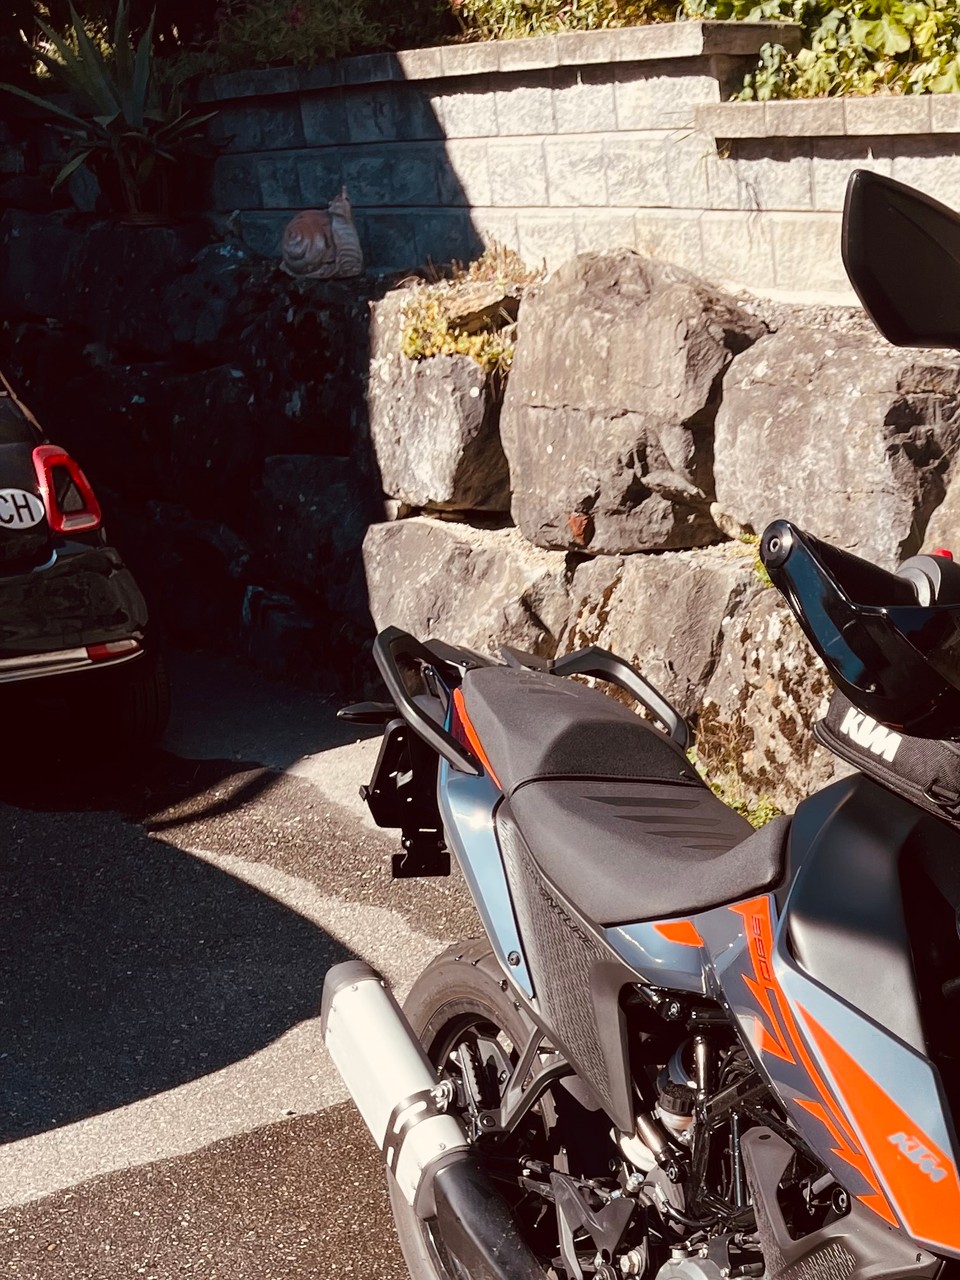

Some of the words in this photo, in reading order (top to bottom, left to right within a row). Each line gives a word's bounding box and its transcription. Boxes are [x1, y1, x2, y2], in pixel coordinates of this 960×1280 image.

[0, 494, 35, 524] CH
[840, 706, 902, 763] KTM
[887, 1131, 948, 1183] KTM
